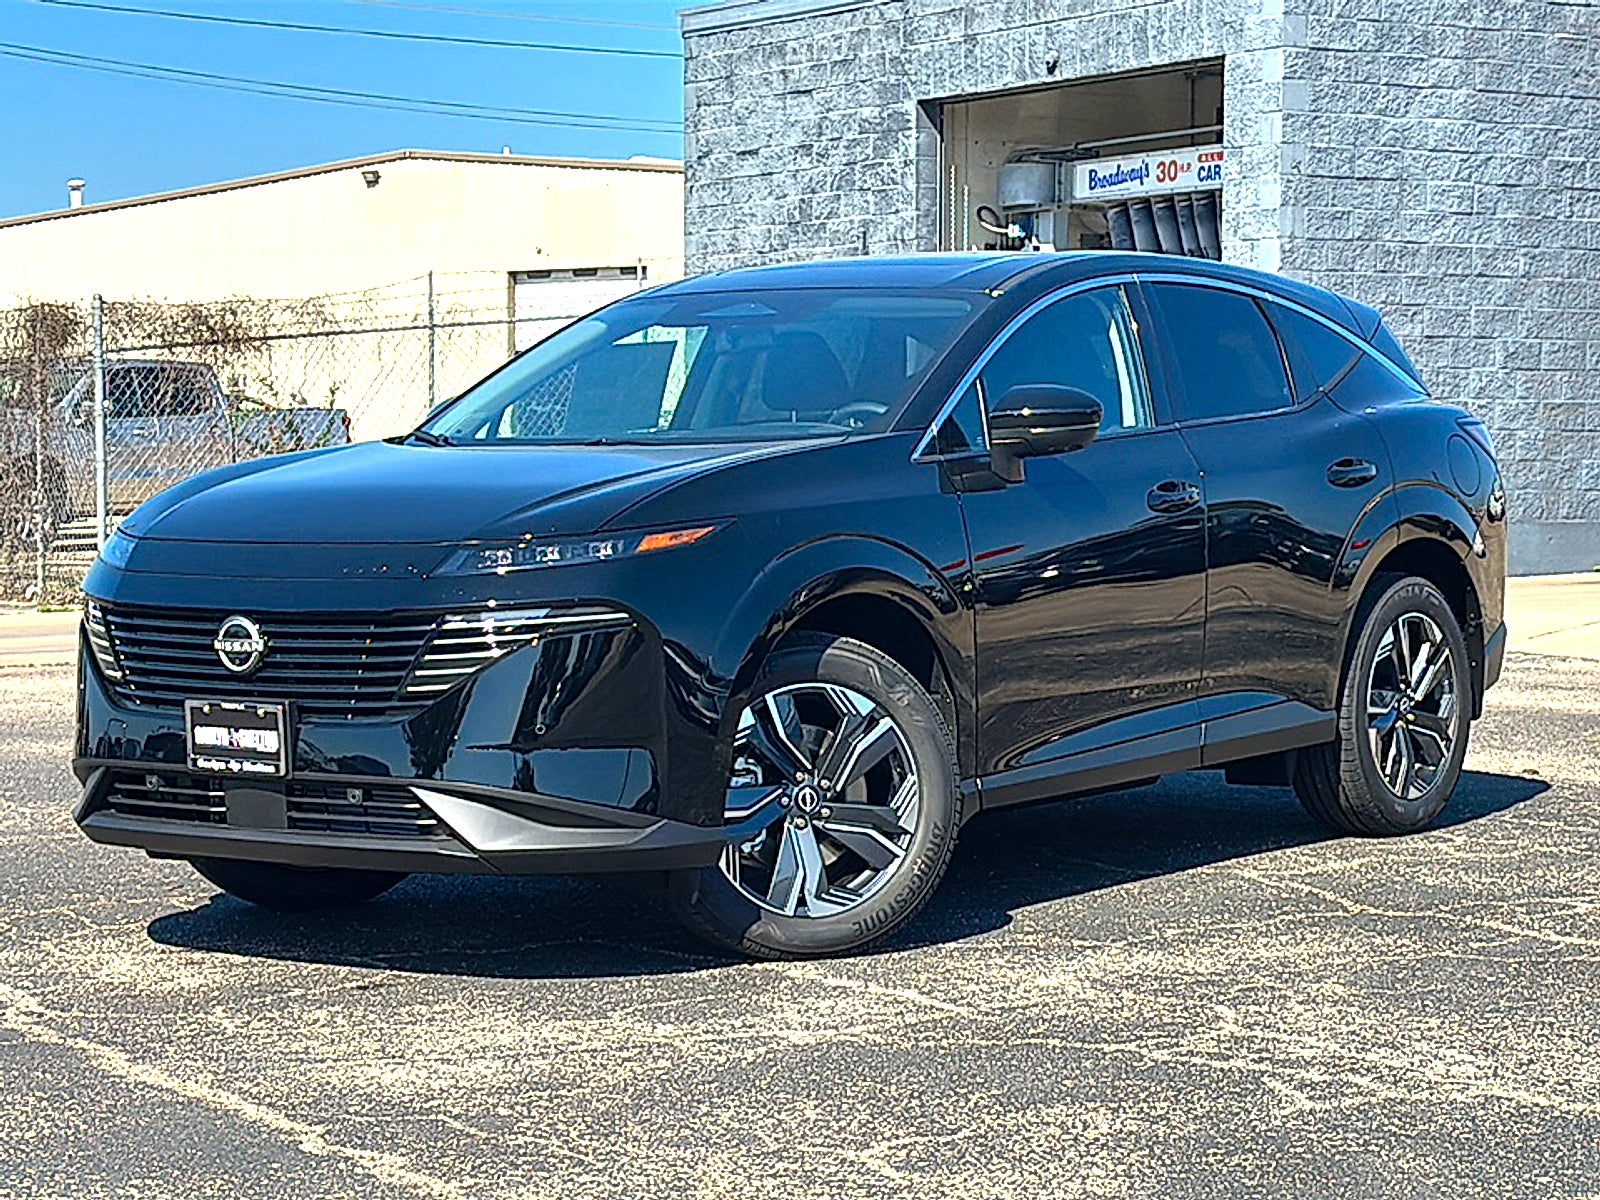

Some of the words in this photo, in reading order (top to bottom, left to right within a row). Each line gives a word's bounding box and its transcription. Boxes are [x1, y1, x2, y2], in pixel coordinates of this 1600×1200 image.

[1088, 159, 1150, 191] Broadway's
[1156, 159, 1178, 183] 30
[1197, 163, 1222, 182] CAR
[213, 639, 264, 652] NISSAN
[852, 821, 945, 938] BRIDGESTONE
